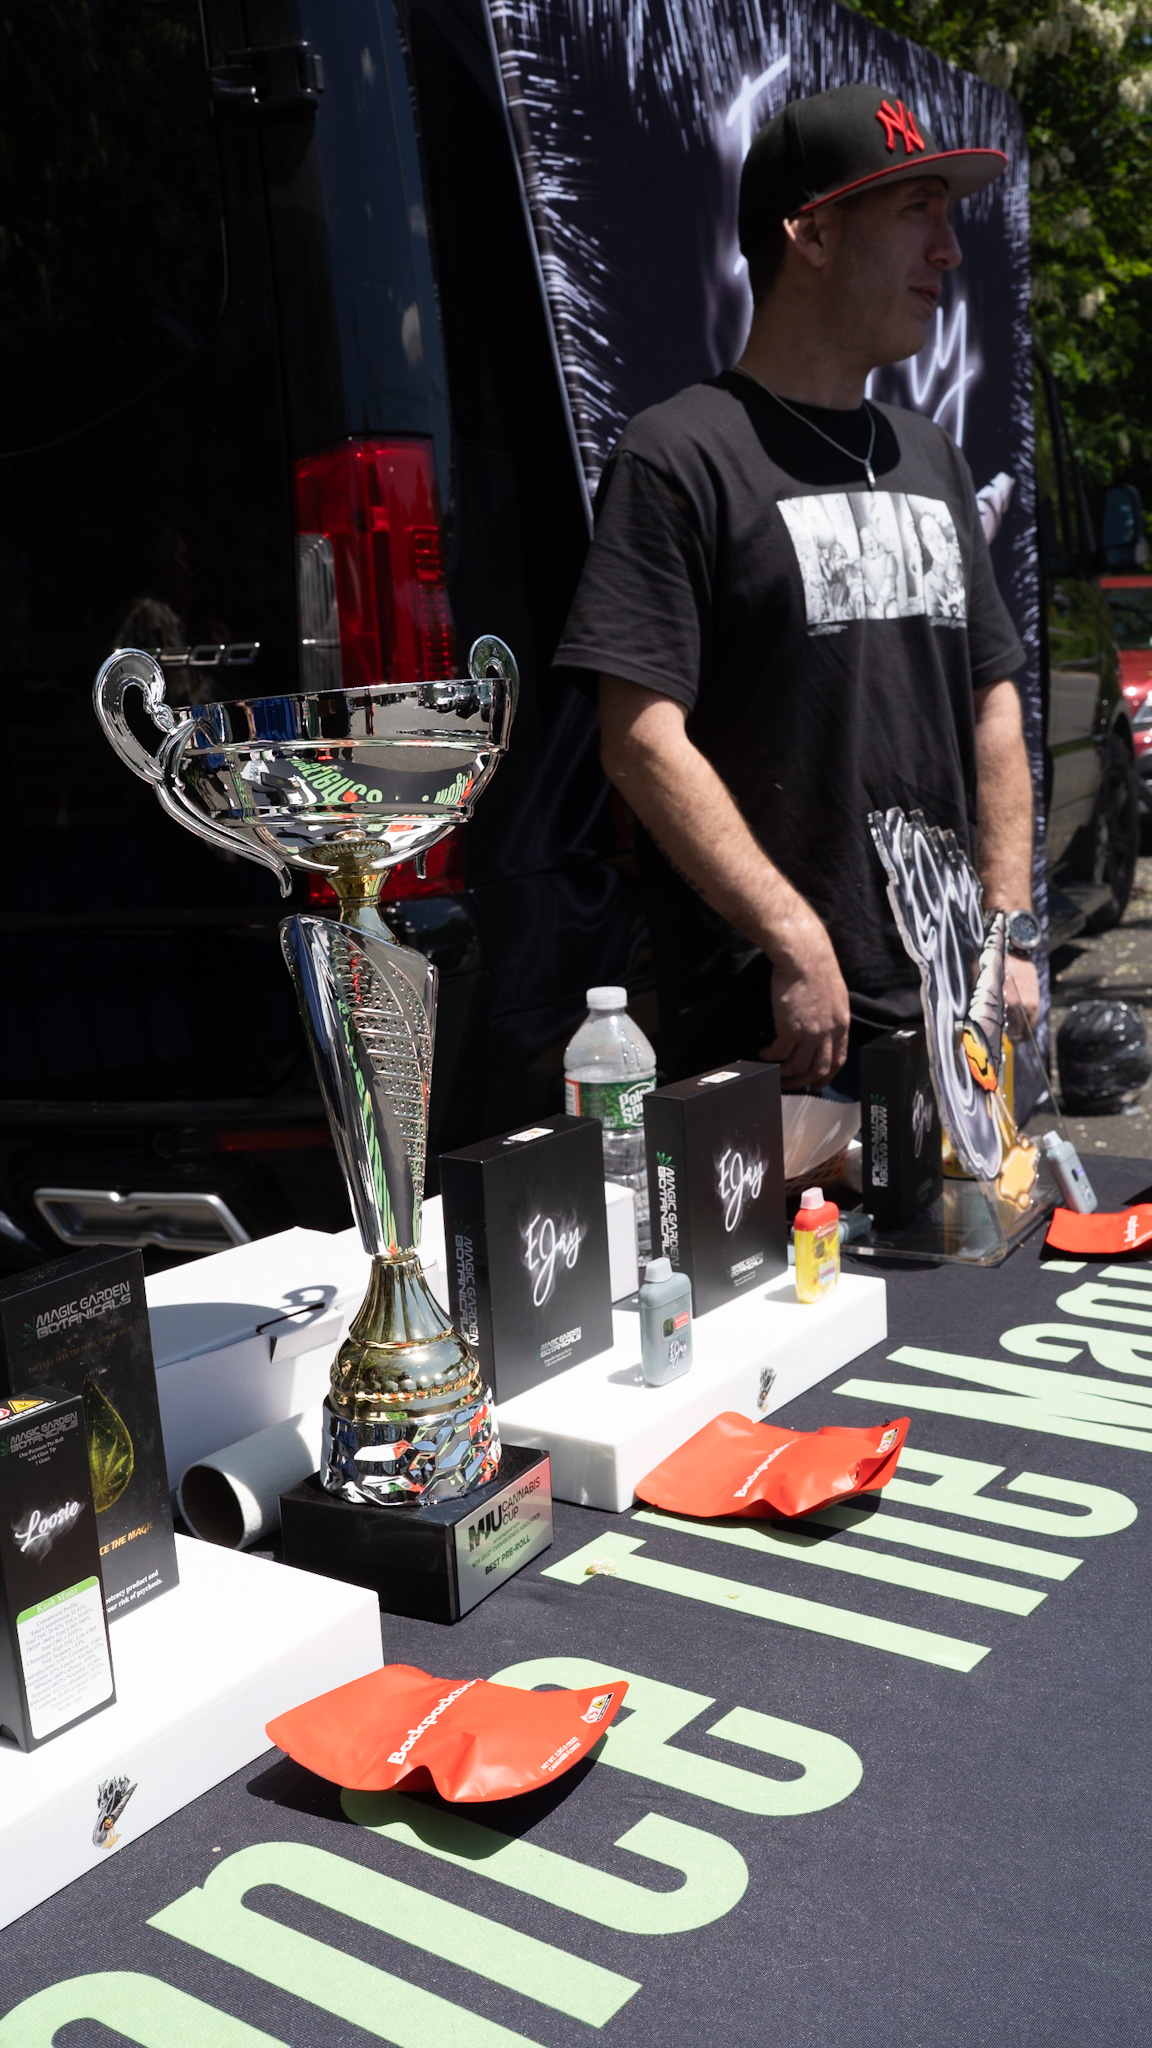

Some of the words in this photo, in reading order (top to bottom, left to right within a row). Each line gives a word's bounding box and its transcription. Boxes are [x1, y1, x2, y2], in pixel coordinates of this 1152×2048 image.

[664, 1167, 677, 1211] MAGIC
[718, 1148, 764, 1232] EJay
[463, 1236, 475, 1286] MAGIC
[525, 1214, 581, 1307] EJay
[668, 1212, 680, 1267] GARDEN
[36, 1301, 79, 1328] MAGIC
[80, 1280, 130, 1309] GARDEN
[36, 1293, 131, 1340] BOTANICALS
[468, 1286, 480, 1347] GARDEN
[10, 1426, 40, 1446] MAGIC
[40, 1411, 78, 1430] GARDEN
[10, 1419, 79, 1454] BOTANICALS
[14, 1501, 81, 1553] Loosie
[468, 1504, 502, 1552] MJU
[501, 1476, 541, 1512] CANNABIS
[502, 1506, 519, 1526] CUP
[110, 1534, 127, 1550] THE
[485, 1557, 501, 1575] BEST
[501, 1534, 531, 1562] PRE-ROLL
[36, 1599, 56, 1614] Kush
[57, 1588, 78, 1601] Mintz
[106, 1602, 118, 1613] our
[118, 1596, 130, 1607] risk
[130, 1591, 137, 1600] of
[126, 1576, 148, 1595] product
[148, 1569, 159, 1580] and
